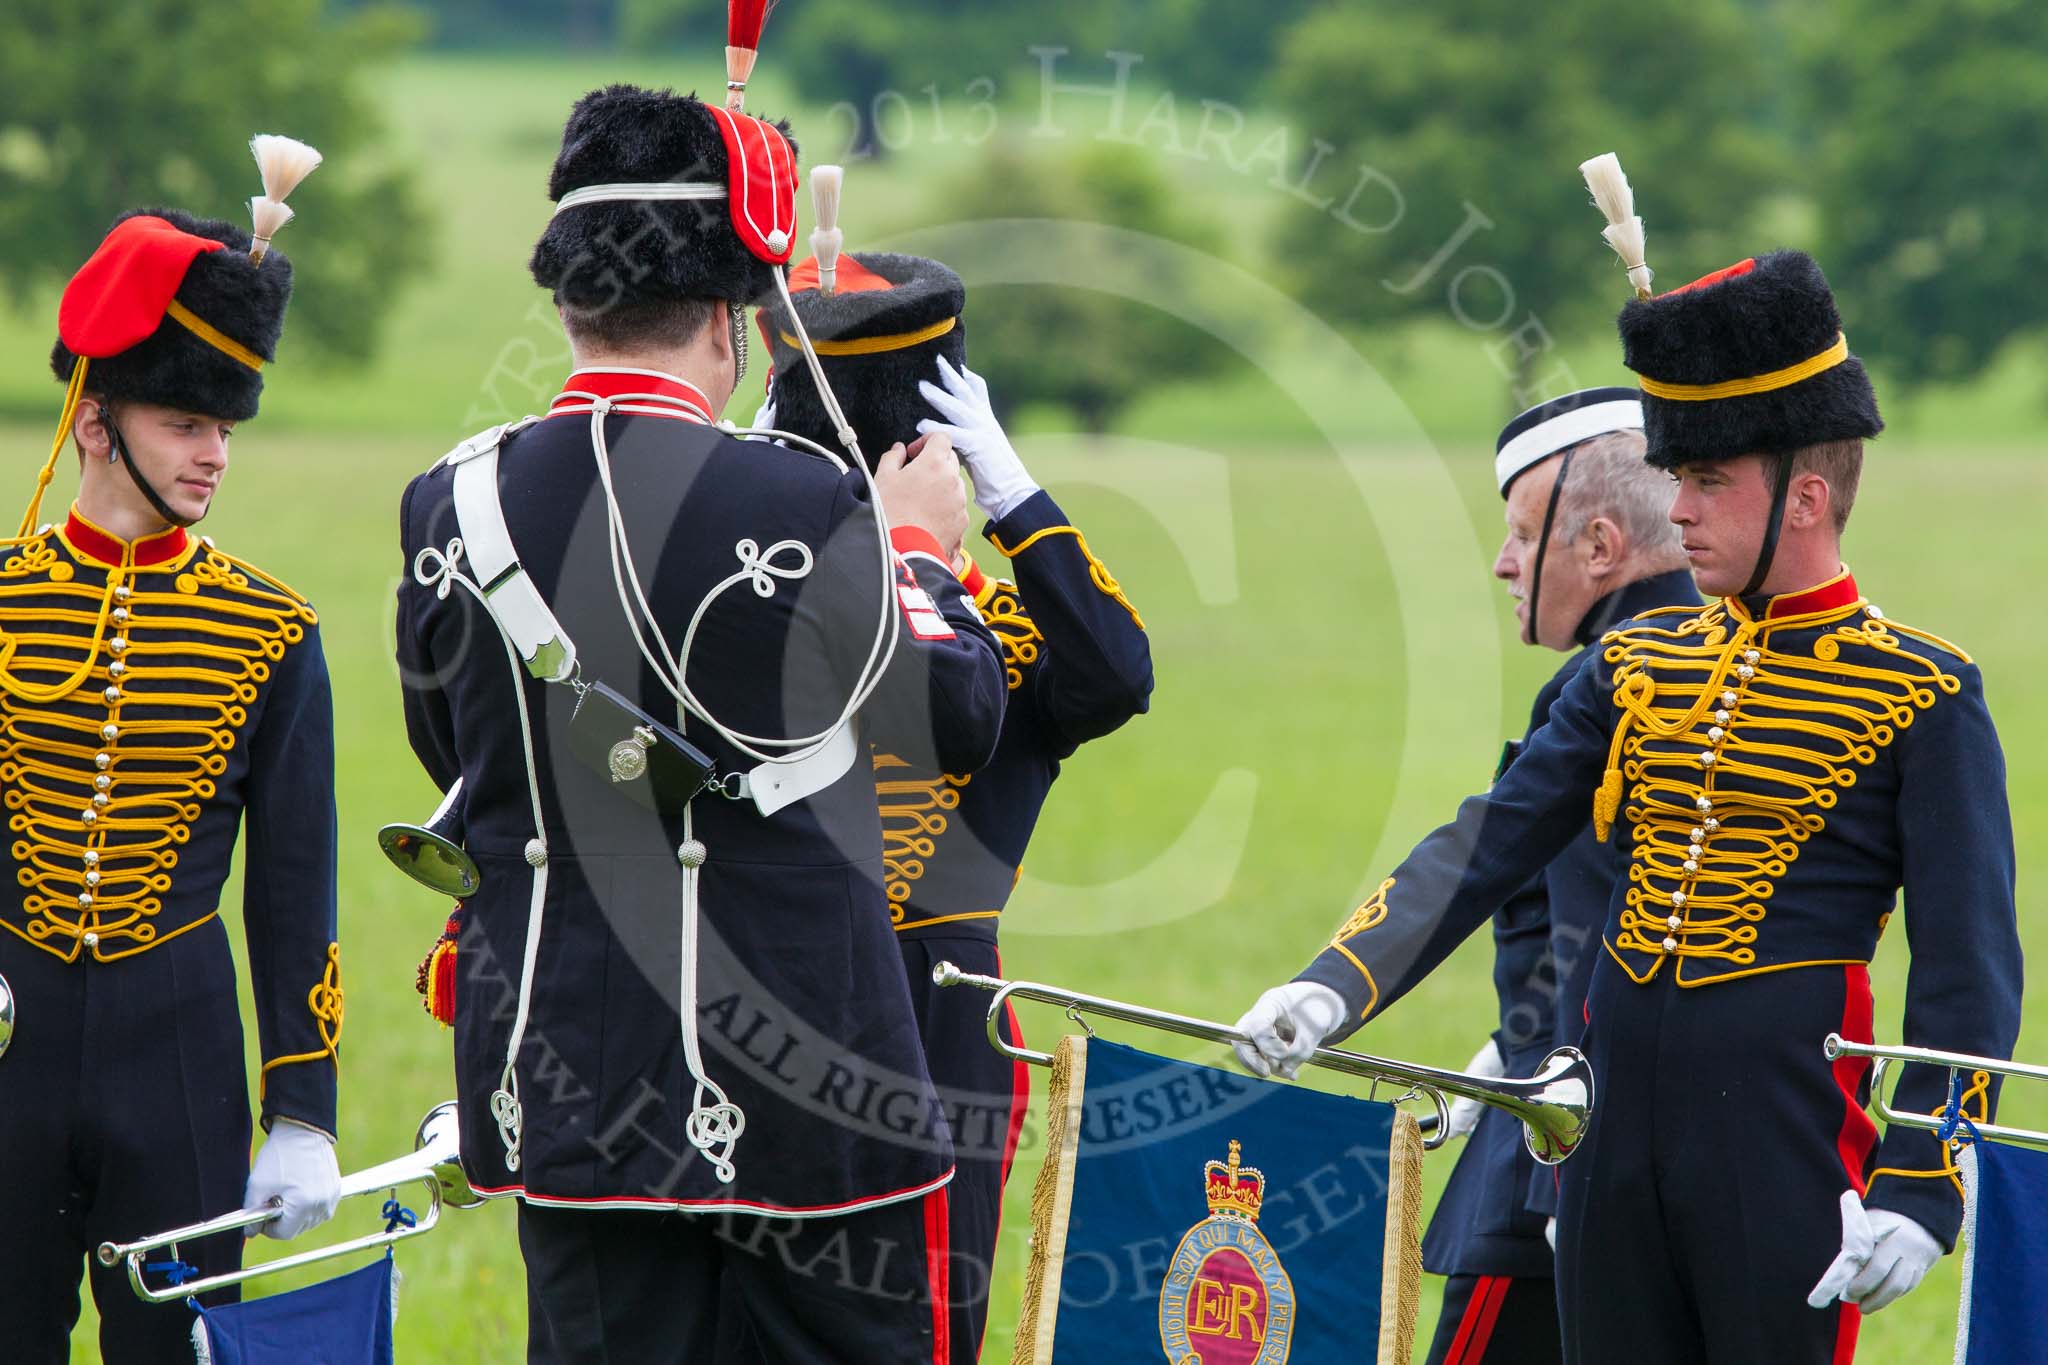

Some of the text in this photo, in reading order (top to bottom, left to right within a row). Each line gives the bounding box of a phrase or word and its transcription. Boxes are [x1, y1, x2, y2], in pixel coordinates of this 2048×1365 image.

[1199, 1224, 1228, 1248] QUI
[1236, 1228, 1273, 1276] MAL
[1174, 1243, 1200, 1286] SOIT
[1270, 1278, 1286, 1293] Y
[1167, 1295, 1185, 1347] HONI
